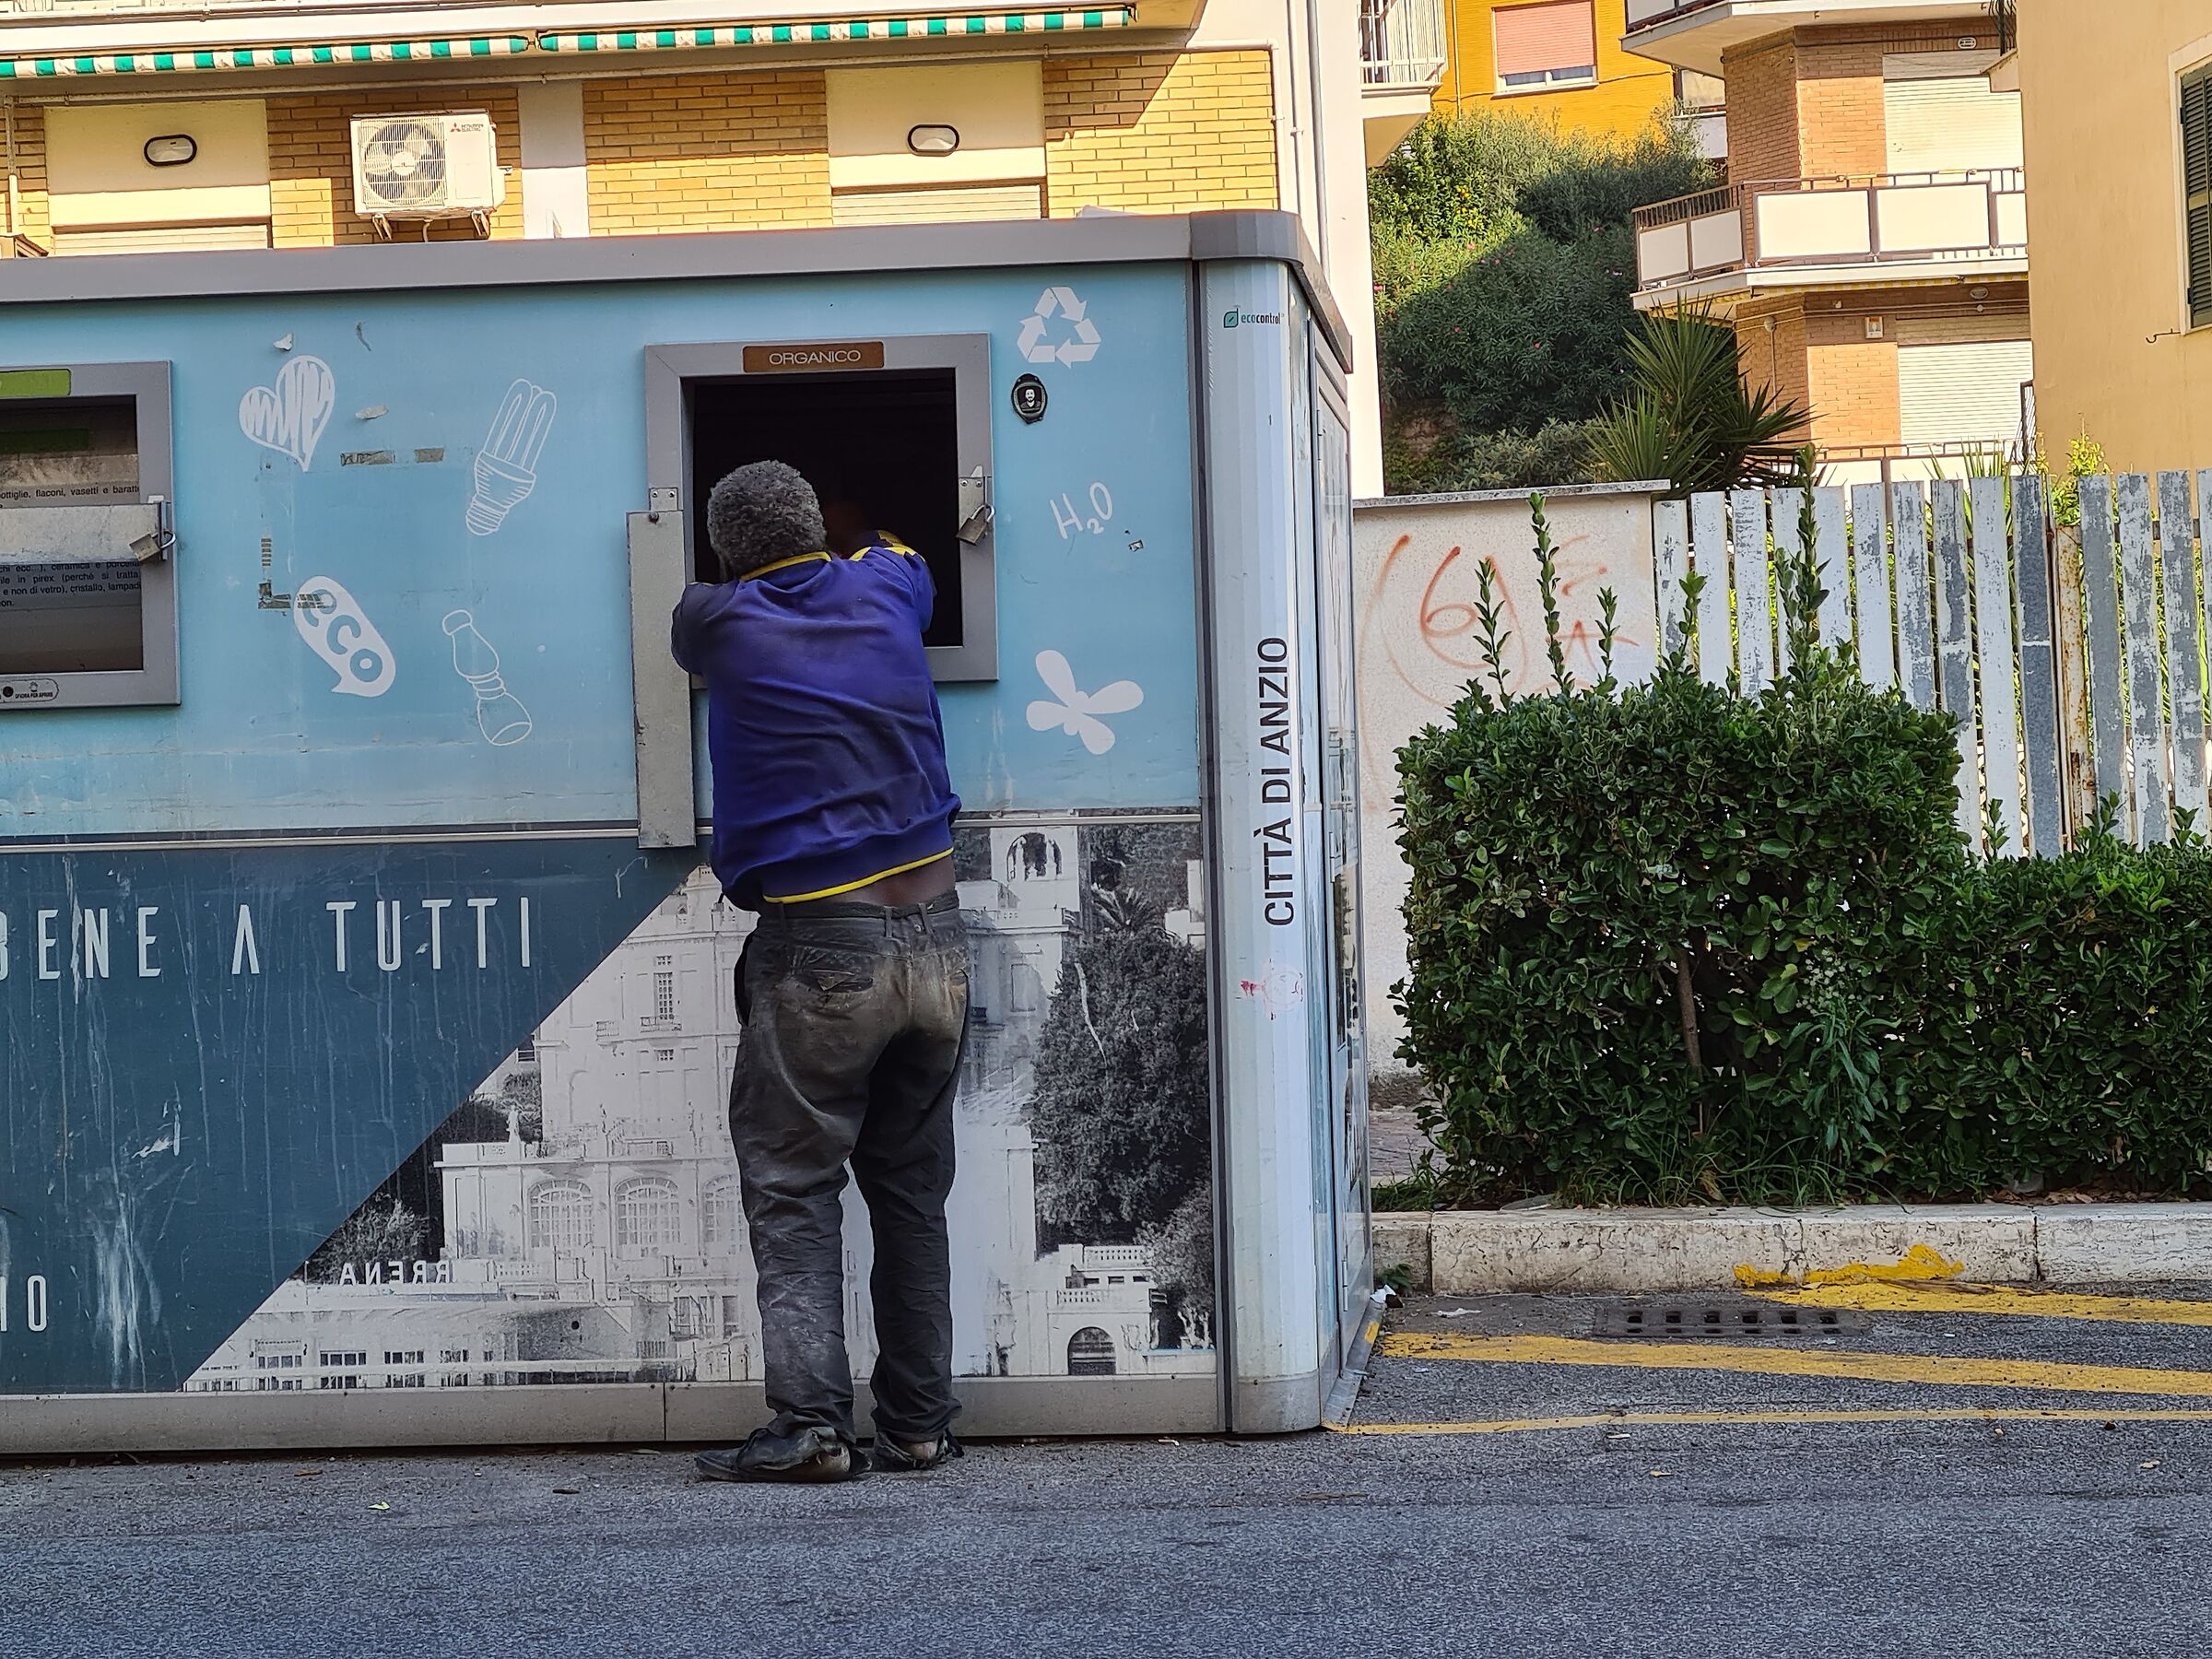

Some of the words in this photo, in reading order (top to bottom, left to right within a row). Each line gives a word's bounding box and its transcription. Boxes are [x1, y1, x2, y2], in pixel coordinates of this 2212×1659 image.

[1241, 312, 1281, 324] ecocontrol
[769, 349, 862, 365] ORGANICO
[0, 488, 31, 500] ottiglie,
[35, 488, 66, 498] flaconi,
[70, 486, 99, 496] vasetti
[33, 574, 54, 584] pirex
[101, 571, 110, 580] si
[116, 571, 139, 580] tratta
[29, 585, 38, 594] di
[41, 584, 67, 594] vetro),
[70, 582, 105, 593] cristallo,
[1256, 636, 1291, 756] ANZIO
[1260, 768, 1292, 805] DI
[1253, 817, 1295, 926] CITTÀ
[231, 904, 260, 975] A
[325, 897, 531, 971] TUTTI
